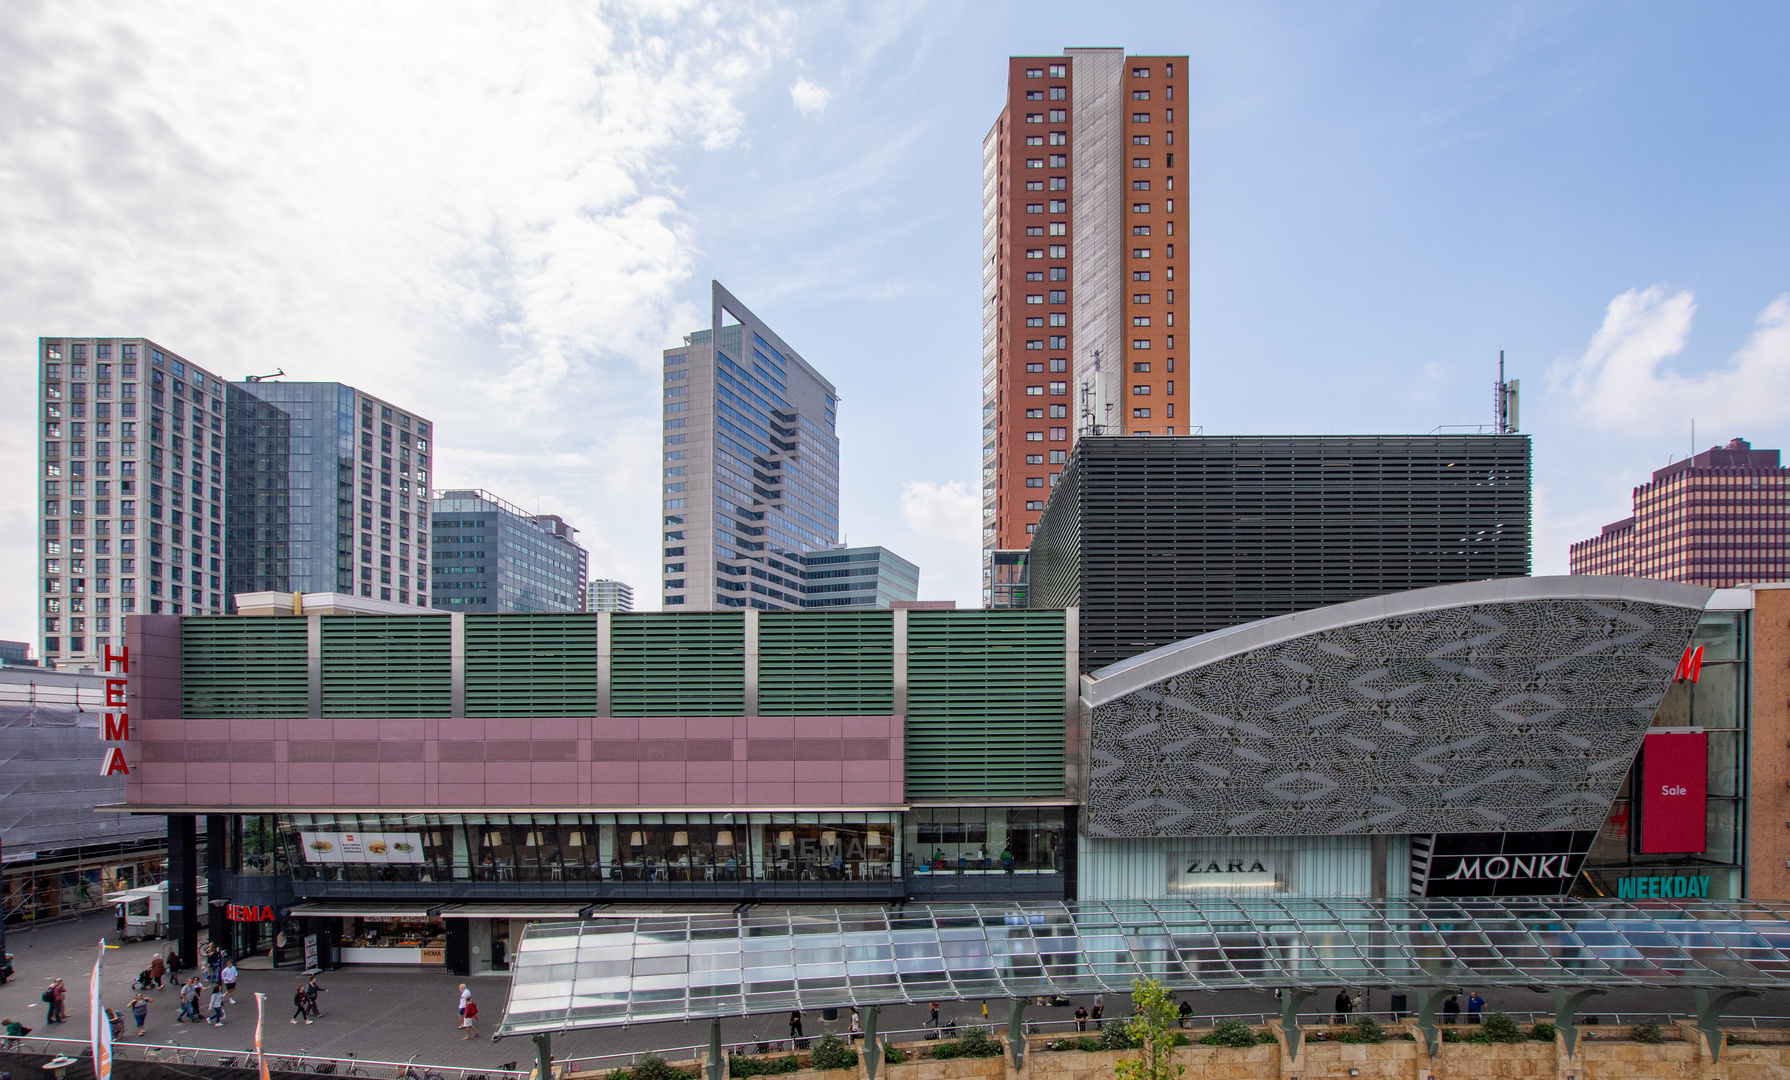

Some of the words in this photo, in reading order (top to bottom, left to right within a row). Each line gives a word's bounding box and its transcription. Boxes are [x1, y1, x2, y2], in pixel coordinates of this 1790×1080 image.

[101, 644, 129, 776] HEMA
[1662, 785, 1687, 796] Sale
[776, 838, 864, 860] HEMA
[1187, 859, 1268, 874] ZARA
[1446, 856, 1572, 880] MONKI
[1617, 875, 1711, 899] WEEKDAY
[226, 903, 276, 922] HEMA
